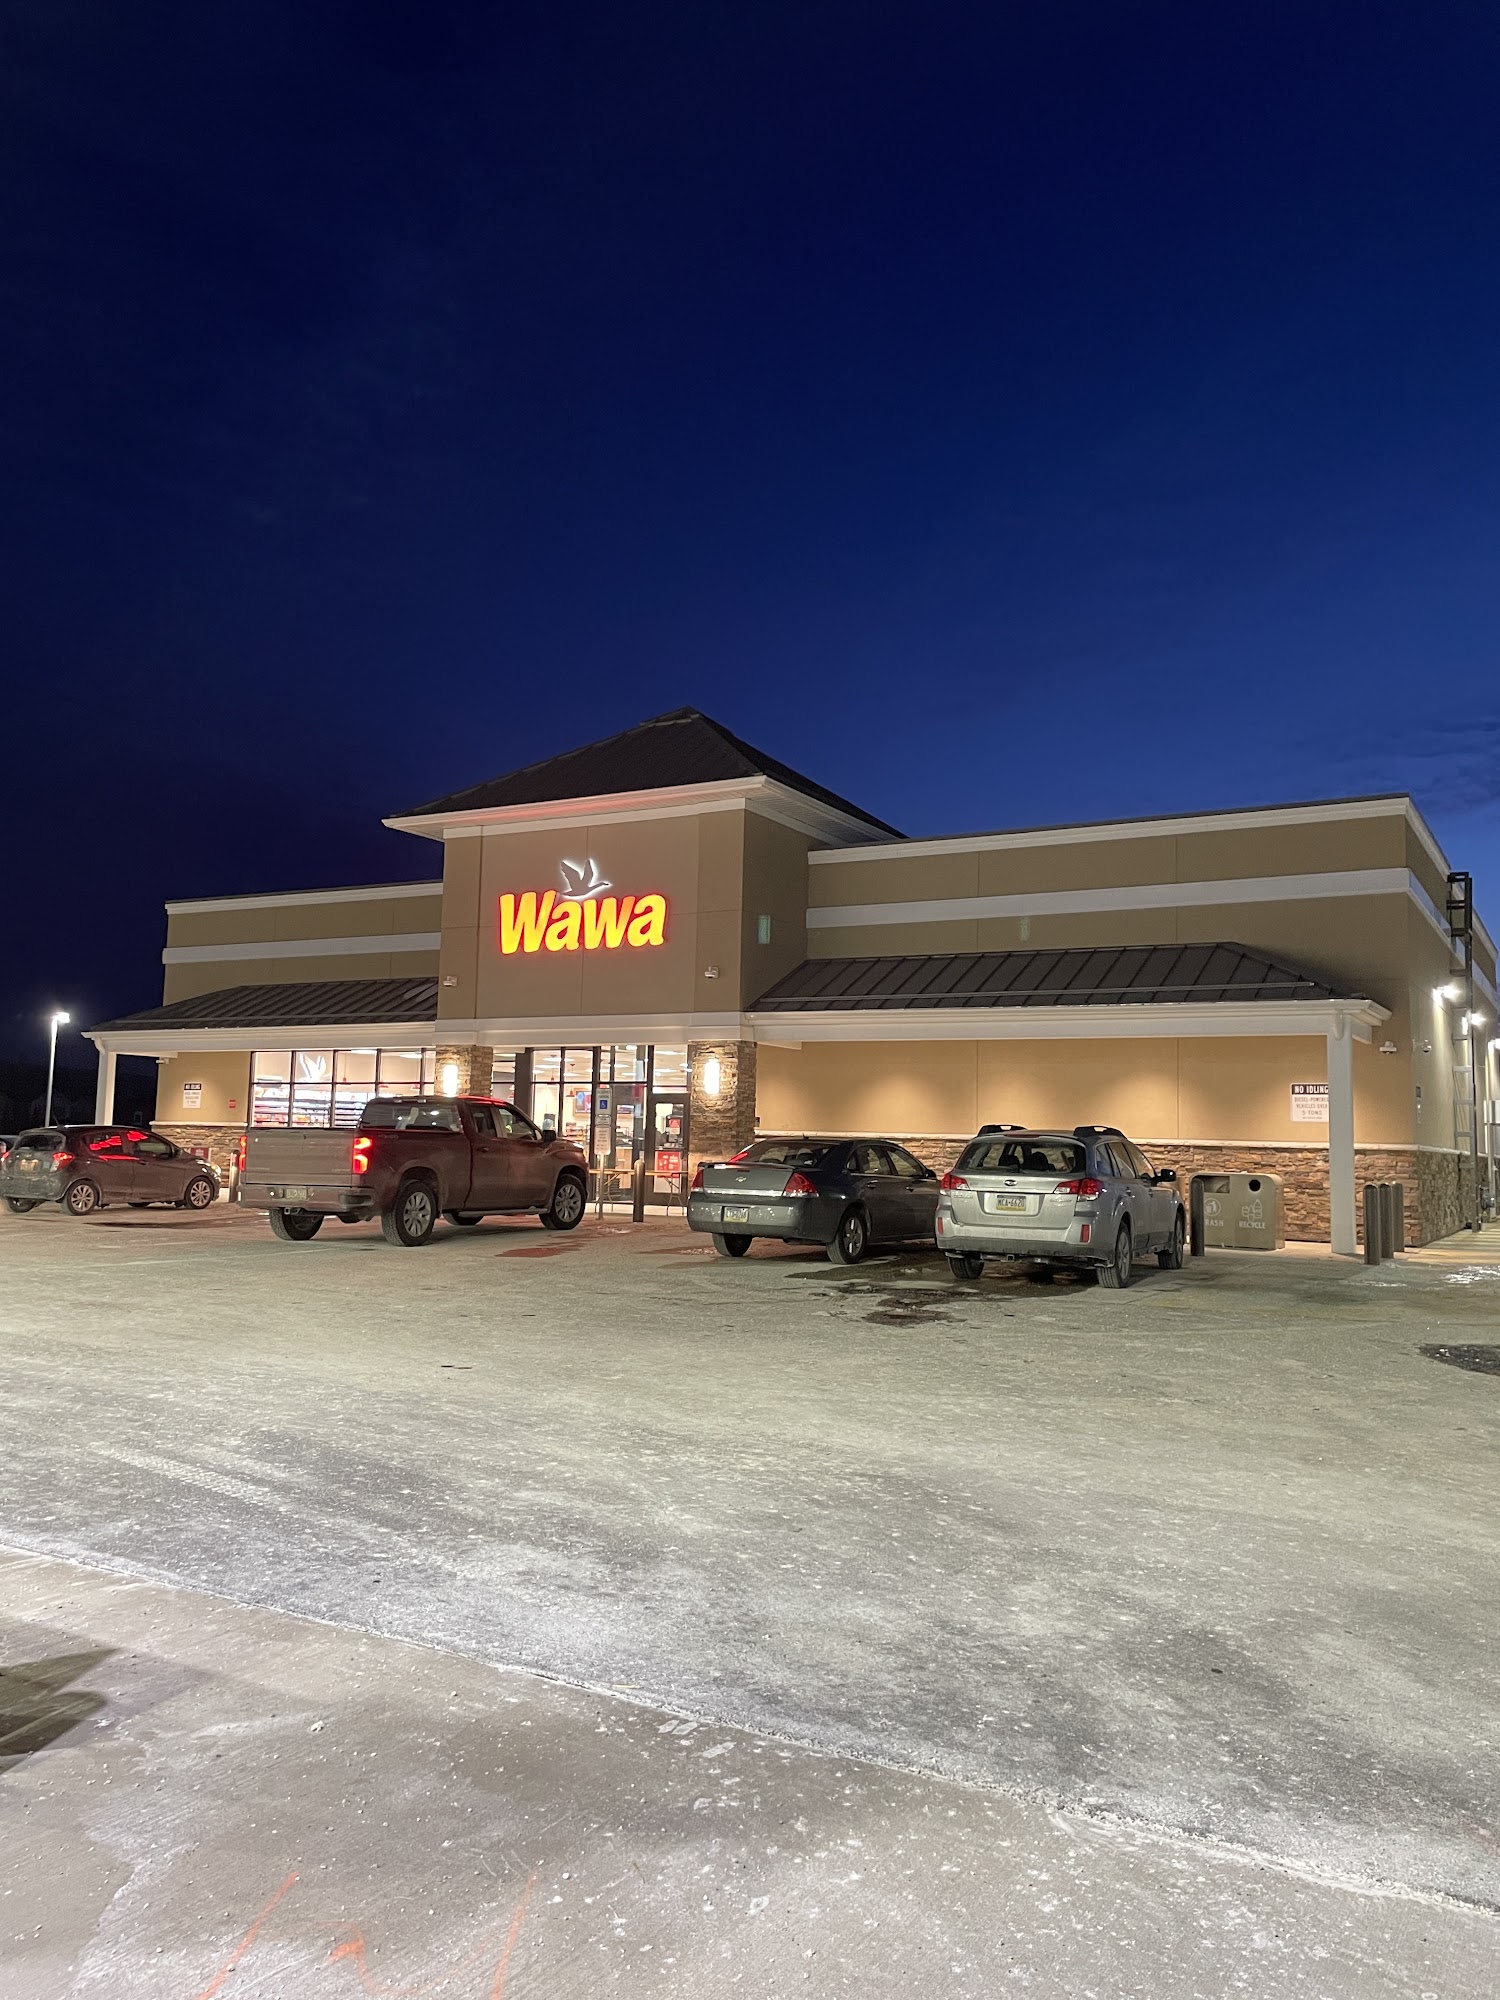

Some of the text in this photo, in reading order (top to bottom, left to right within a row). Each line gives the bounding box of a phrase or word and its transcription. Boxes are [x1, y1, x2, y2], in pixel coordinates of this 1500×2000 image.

[499, 890, 667, 954] Wawa
[1294, 1085, 1329, 1094] NO IDLING
[1204, 1219, 1224, 1227] RASH
[1238, 1220, 1266, 1229] RECYCLE
